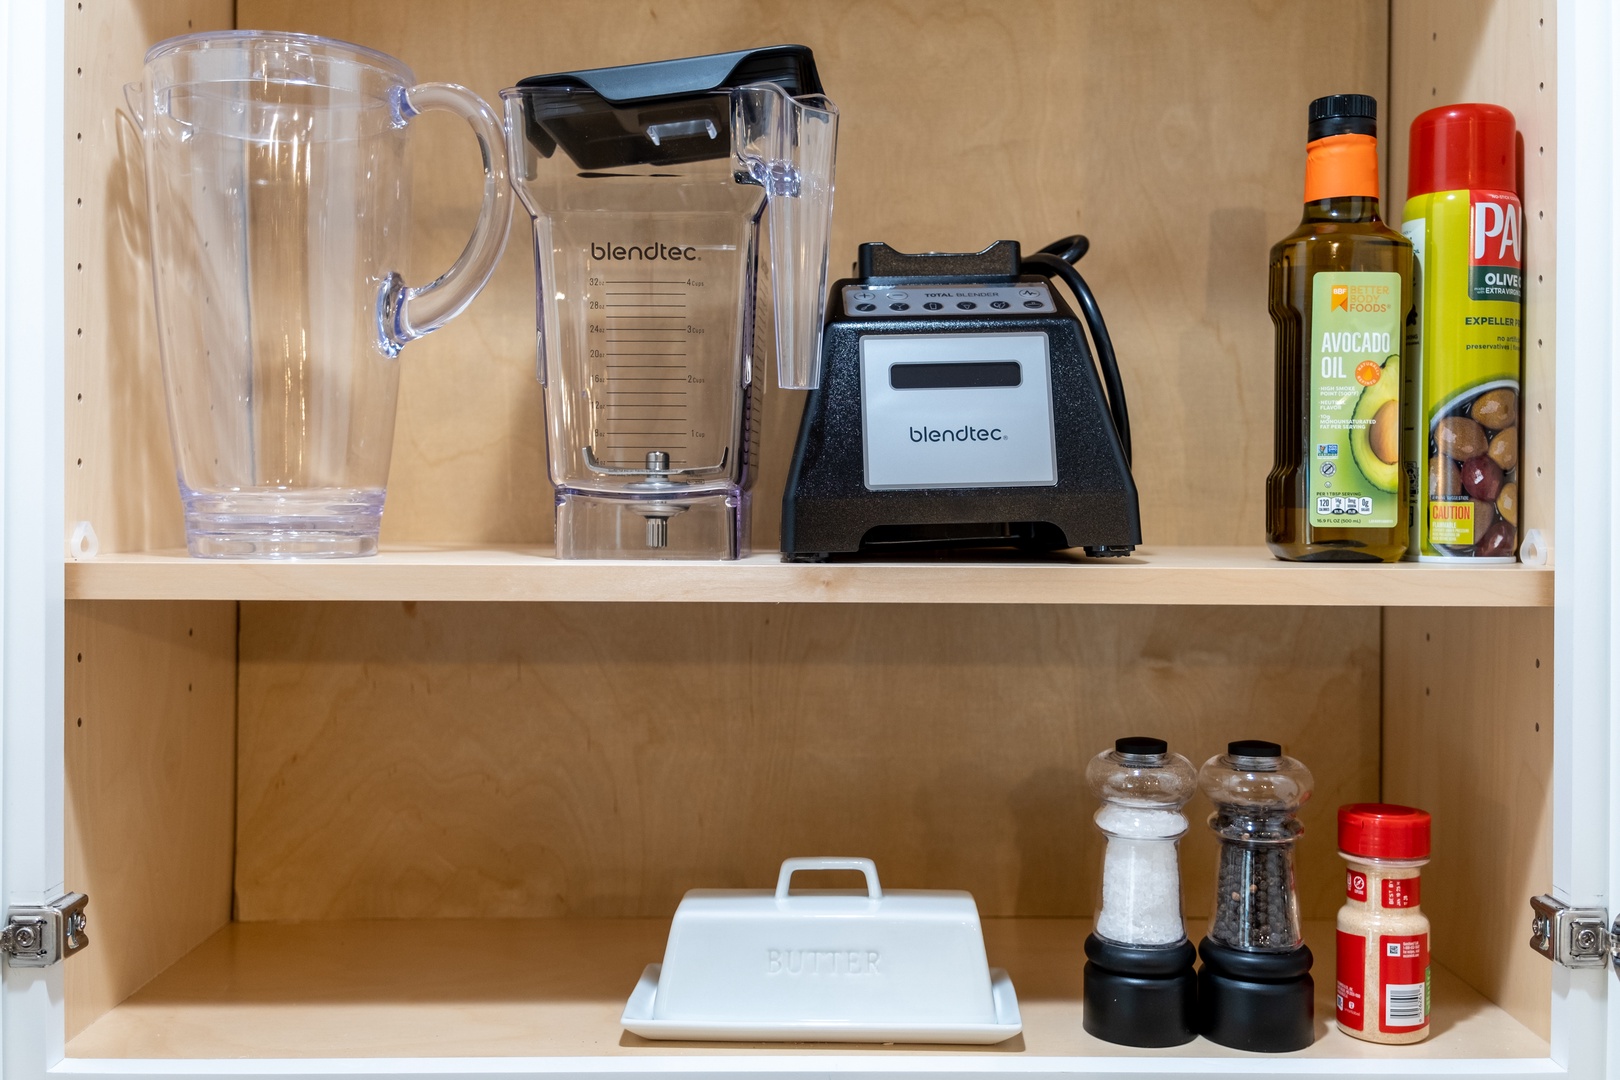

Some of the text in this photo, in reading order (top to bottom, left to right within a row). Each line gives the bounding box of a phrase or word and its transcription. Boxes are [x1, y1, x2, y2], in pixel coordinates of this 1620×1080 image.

[1474, 202, 1521, 262] PA
[1484, 272, 1518, 287] OLIVE
[1350, 286, 1389, 294] BETTER
[1350, 294, 1380, 303] BODY
[1465, 317, 1514, 326] EXPELLER
[1321, 332, 1390, 353] AVOCADO
[1321, 356, 1347, 379] OIL
[1319, 499, 1330, 507] 120
[1432, 505, 1471, 520] CAUTION
[767, 949, 882, 976] BUTTER
